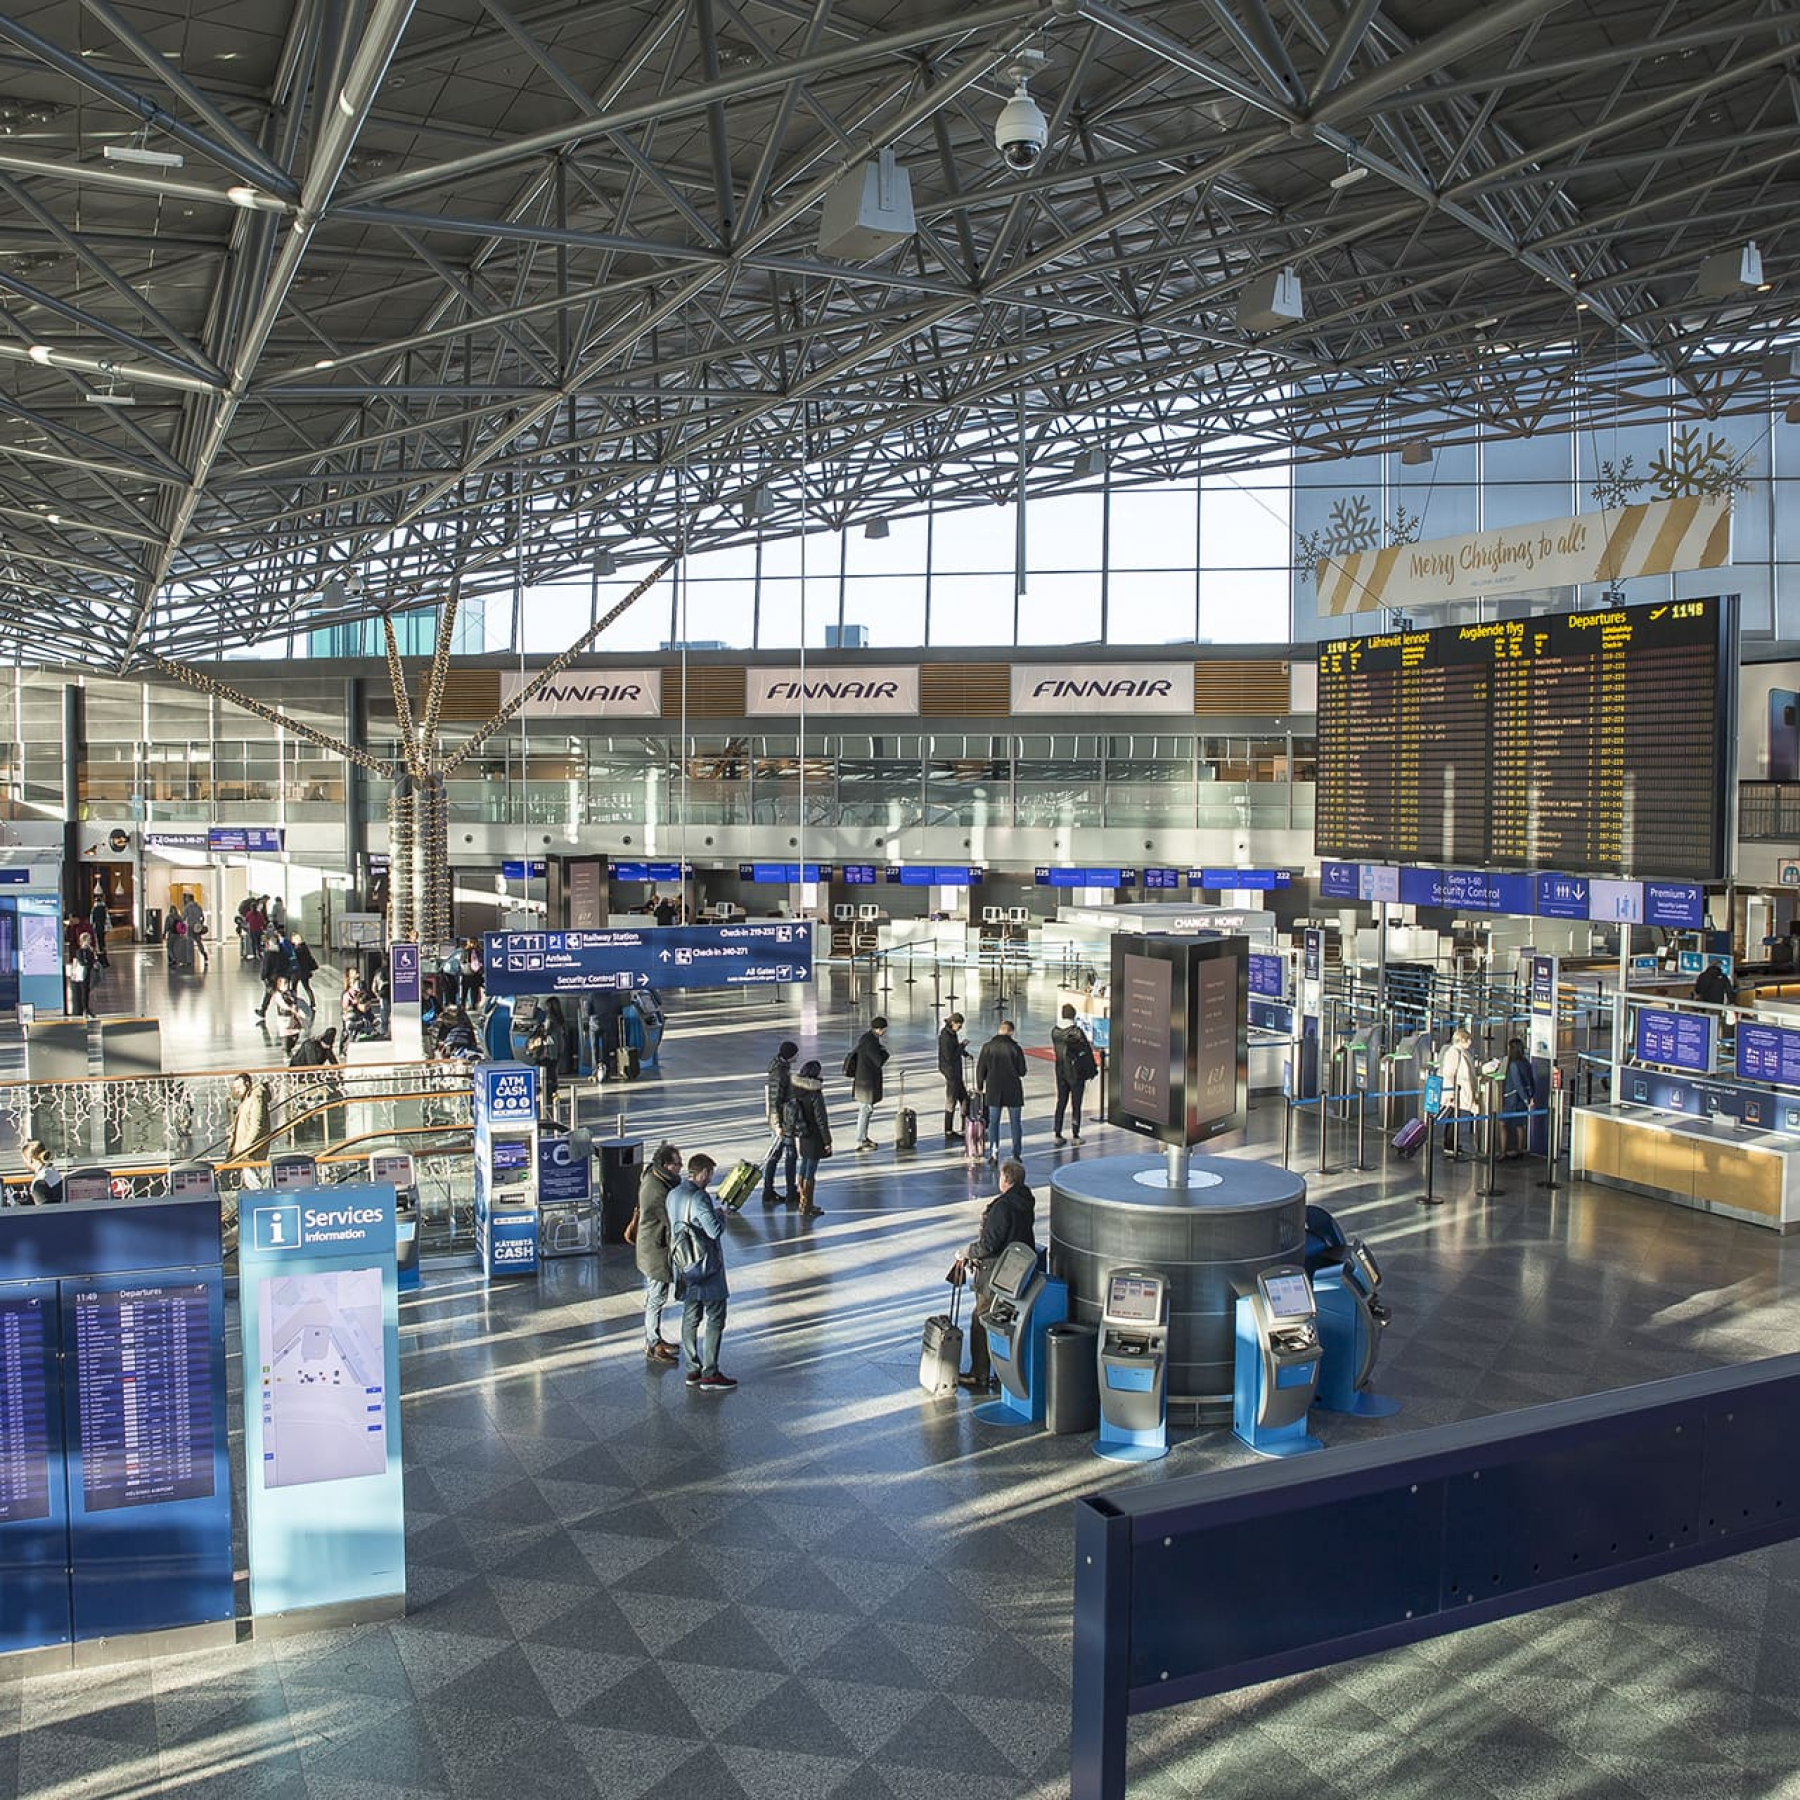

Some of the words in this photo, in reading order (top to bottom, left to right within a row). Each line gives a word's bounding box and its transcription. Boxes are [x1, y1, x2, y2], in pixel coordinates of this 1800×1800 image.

[1409, 553, 1455, 585] Merry
[1460, 537, 1533, 573] Christmas
[1538, 529, 1552, 560] to
[1557, 523, 1587, 554] all!
[1672, 603, 1704, 619] 1148
[1568, 612, 1626, 630] Departures
[1459, 624, 1505, 642] Avgående
[1507, 622, 1524, 637] flyg
[1368, 635, 1400, 649] Lähtevät
[1402, 632, 1430, 645] lennot
[530, 684, 642, 703] INNAIR
[767, 682, 899, 700] FINNAIR
[1032, 680, 1173, 698] FINNAIR
[1187, 870, 1202, 878] 223
[1276, 872, 1290, 880] 222
[1432, 883, 1465, 899] Security
[1467, 884, 1500, 899] Control
[1650, 887, 1686, 899] Premium
[1174, 918, 1210, 928] CHANGE
[1214, 917, 1246, 927] MONEY
[720, 928, 748, 937] Check-in
[524, 937, 540, 949] T1
[583, 932, 611, 943] Railway
[612, 931, 640, 942] Station
[546, 953, 573, 963] Arrivals
[692, 948, 722, 957] Check-in
[745, 967, 755, 976] All
[557, 975, 587, 985] Security
[588, 974, 616, 984] Control
[498, 1076, 524, 1088] ATM
[495, 1085, 527, 1097] CASH
[304, 1205, 383, 1228] Services
[304, 1229, 366, 1243] Information
[494, 1247, 534, 1260] CASH
[76, 1292, 98, 1302] 11:49
[120, 1288, 162, 1299] Departures
